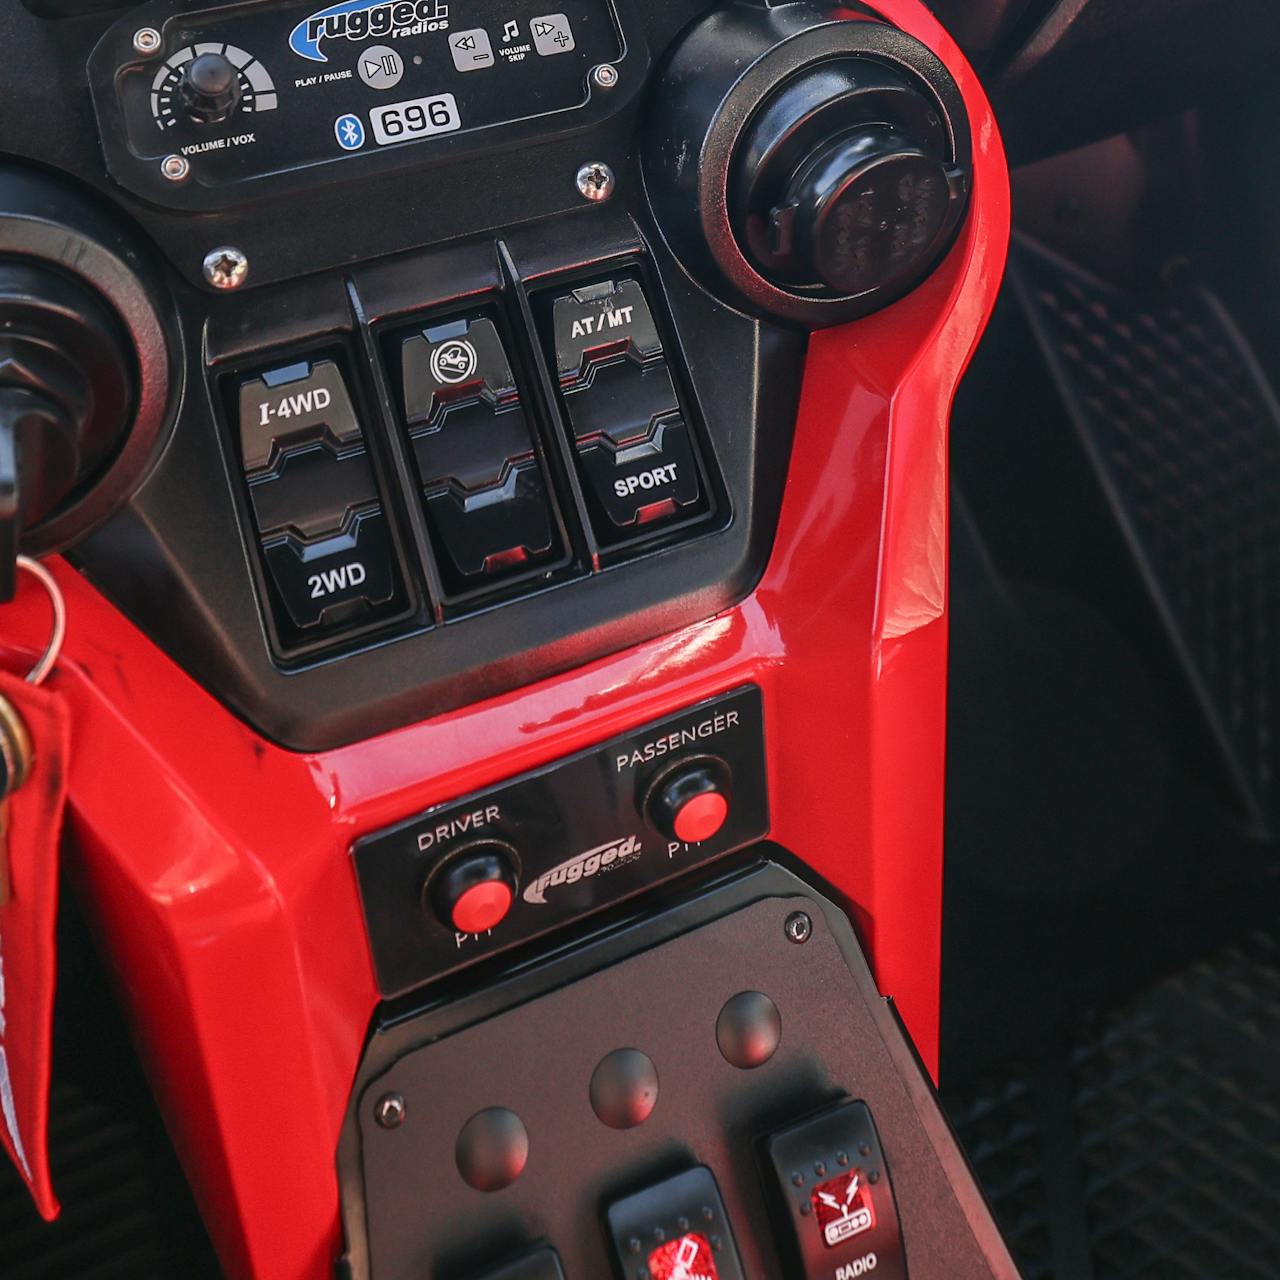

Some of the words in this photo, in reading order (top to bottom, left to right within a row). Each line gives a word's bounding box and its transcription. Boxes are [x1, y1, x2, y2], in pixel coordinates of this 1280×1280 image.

[391, 19, 449, 39] radios
[499, 44, 531, 57] VOLUME
[508, 52, 526, 63] SKIP
[295, 76, 317, 88] PLAY
[324, 69, 353, 82] PAUSE
[380, 100, 451, 137] 696
[258, 387, 331, 426] I-4WD
[613, 463, 679, 498] SPORT
[306, 562, 366, 600] 2WD
[616, 709, 740, 773] PASSENGER
[417, 804, 501, 852] DRIVER
[835, 1251, 878, 1280] RADIO
